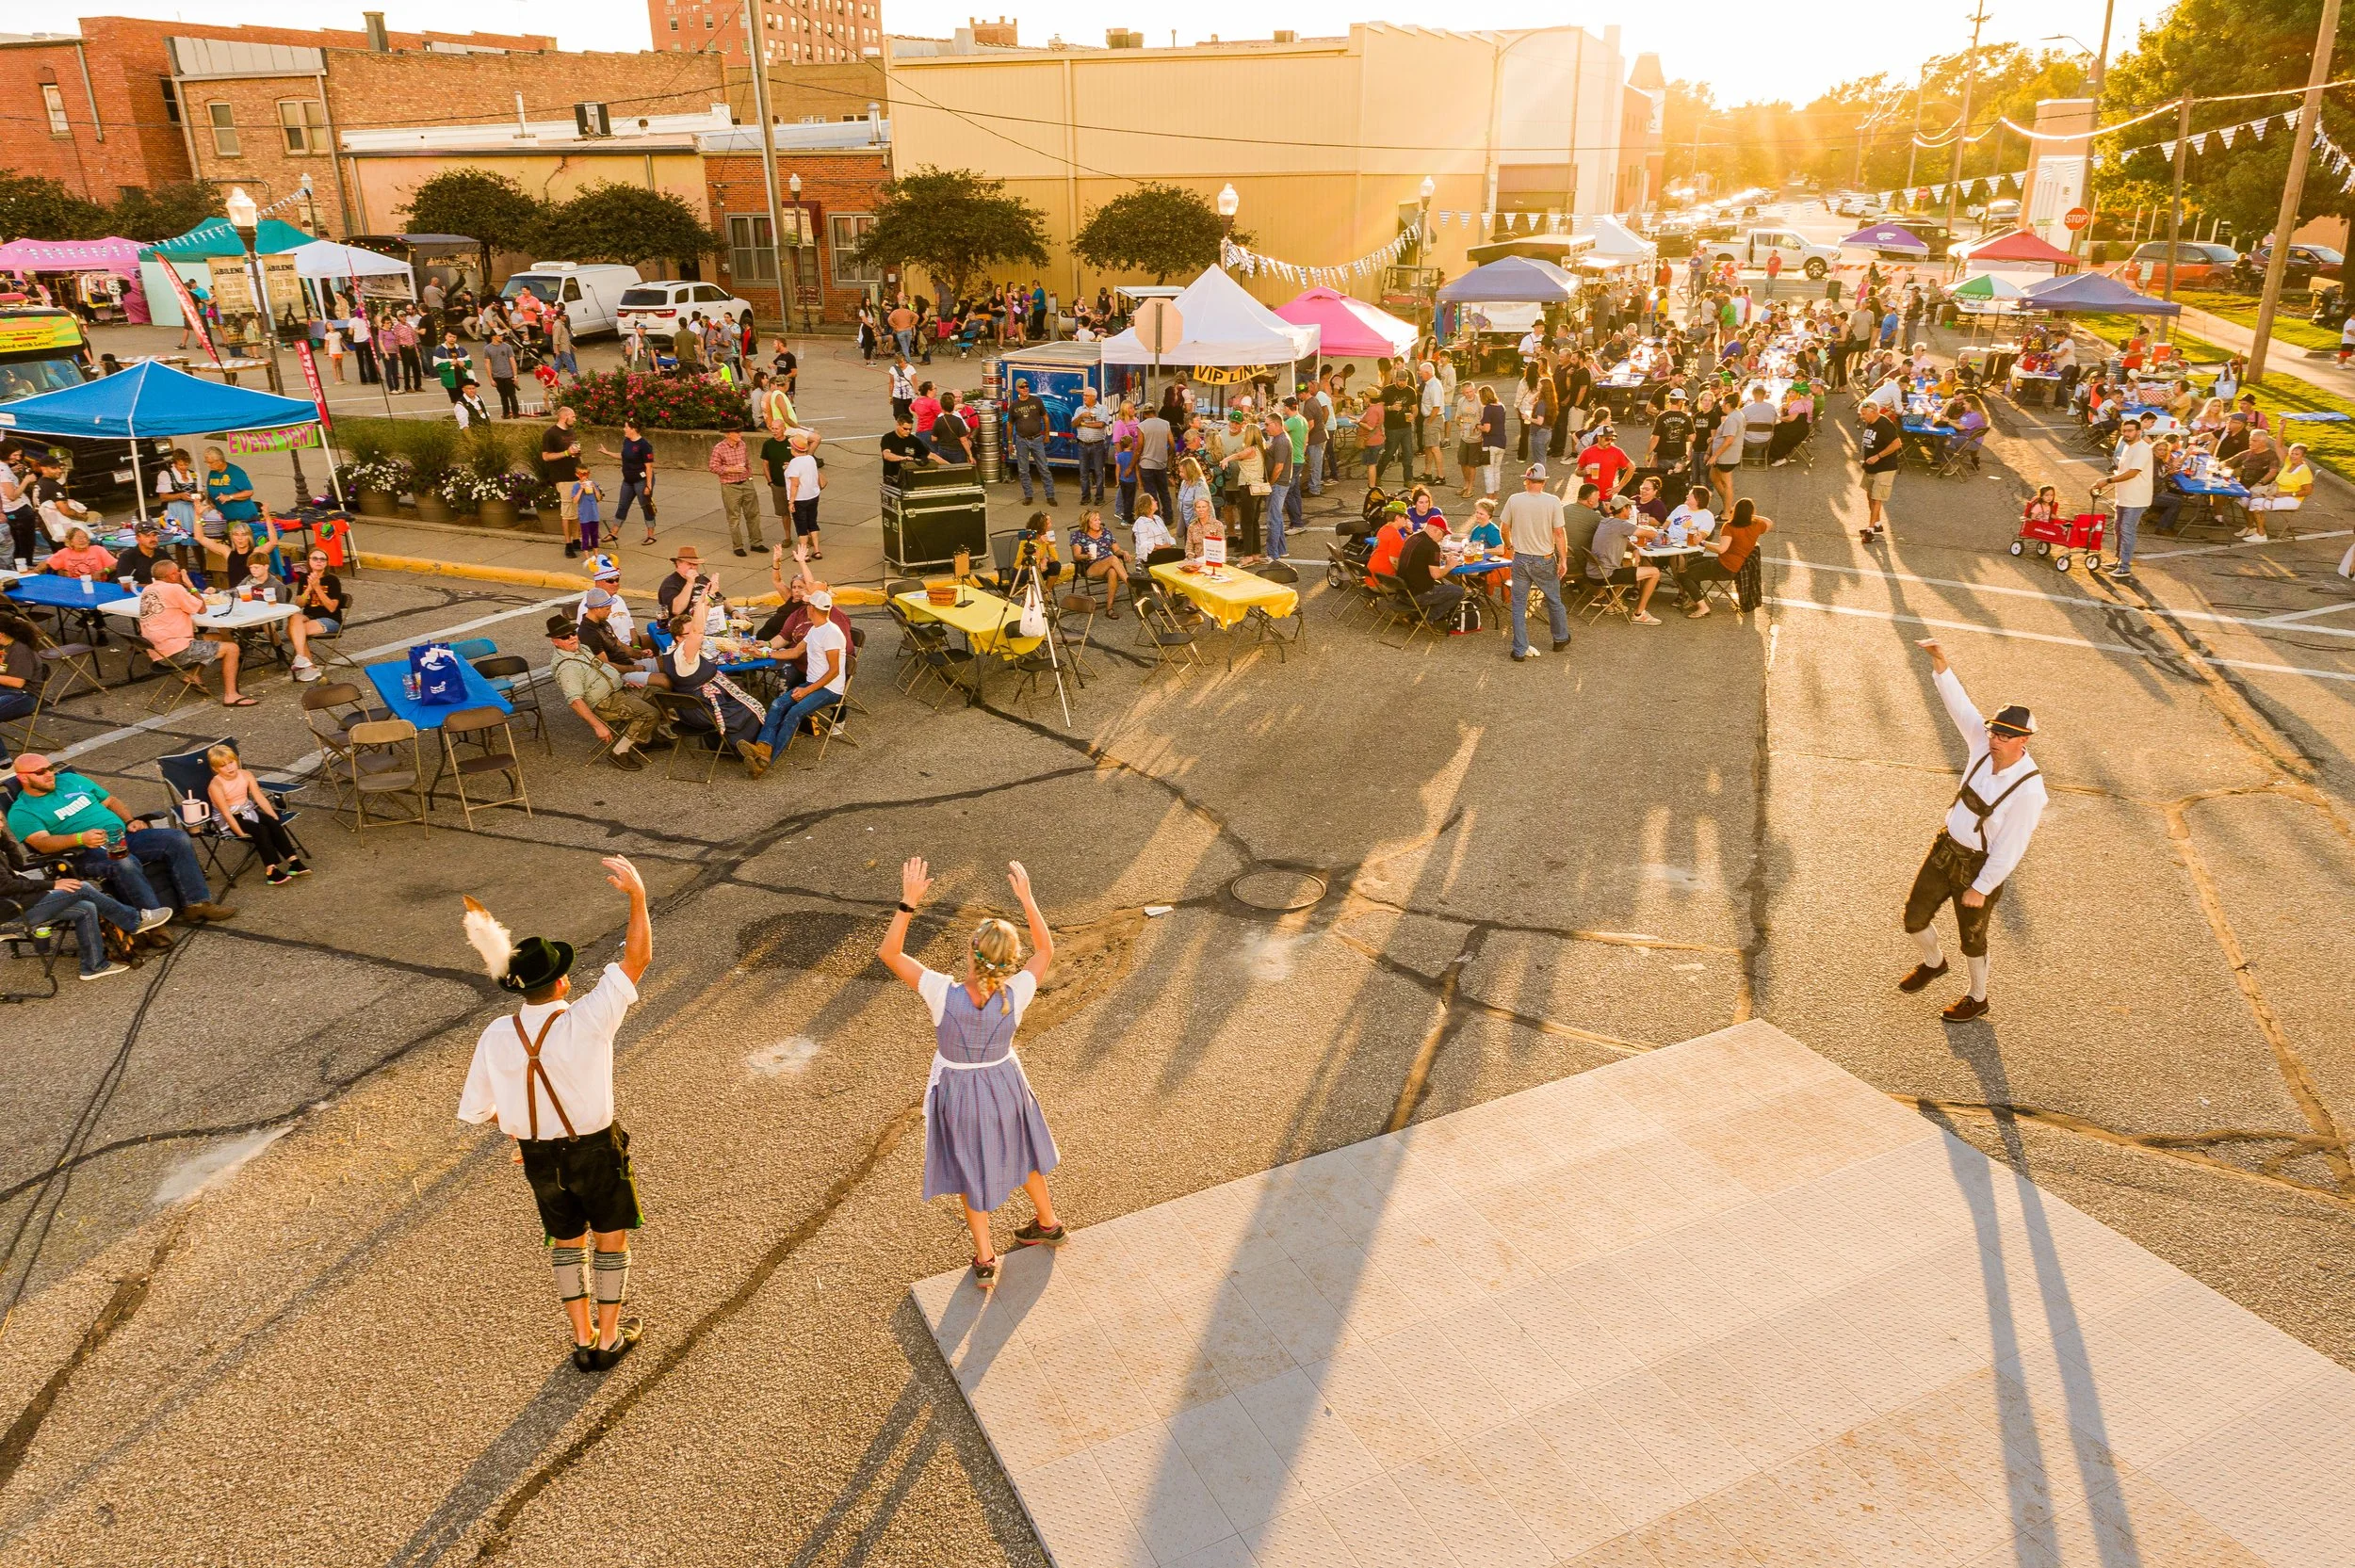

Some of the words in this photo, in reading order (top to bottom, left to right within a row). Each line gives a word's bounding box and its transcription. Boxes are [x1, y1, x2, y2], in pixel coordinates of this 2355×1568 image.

[2065, 215, 2087, 224] STOP
[214, 267, 245, 275] ABILENE
[267, 264, 294, 272] ABILENE
[1197, 364, 1224, 382] VIP
[228, 430, 278, 454] EVENT
[277, 424, 315, 448] TENT
[54, 795, 92, 821] PUMA
